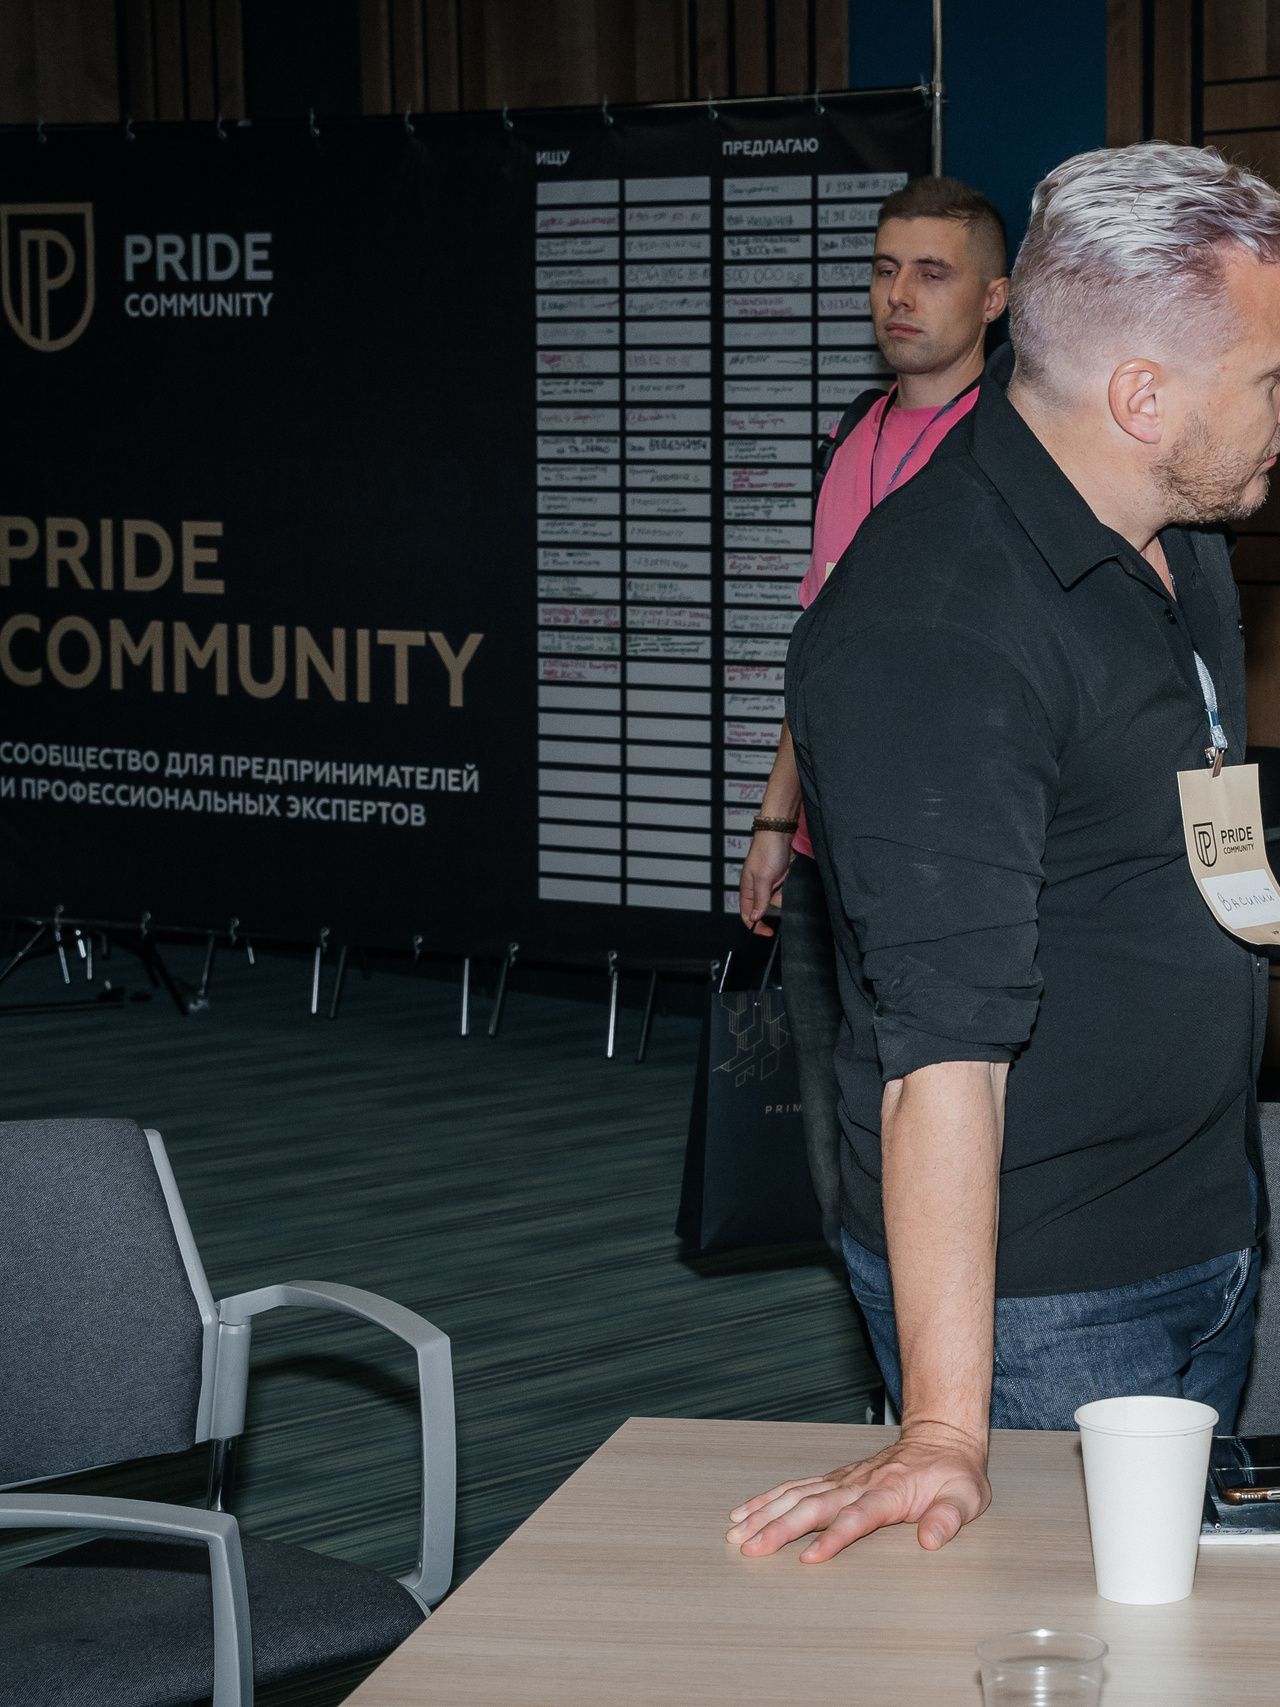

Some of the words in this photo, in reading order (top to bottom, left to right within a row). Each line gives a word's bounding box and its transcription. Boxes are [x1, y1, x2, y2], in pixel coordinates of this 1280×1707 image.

[536, 150, 571, 167] ИЩУ
[722, 137, 820, 158] ПРЕДЛАГАЮ
[125, 234, 274, 282] PRIDE
[125, 294, 274, 318] COMMUNITY
[0, 517, 226, 595] PRIDE
[0, 615, 485, 708] COMMUNITY
[0, 741, 160, 774] СООБЩЕСТВО
[165, 751, 214, 776] ДЛЯ
[221, 756, 480, 793] ПРЕДПРИНИМАТЕЛЕЙ
[0, 777, 15, 798] И
[22, 778, 281, 818] ПРОФЕССИОНАЛЬНЫХ
[287, 796, 427, 826] ЭКСПЕРТОВ
[1221, 827, 1254, 844] PRIDE
[1223, 843, 1255, 855] COMMUNITY
[765, 1103, 803, 1115] PRIM
